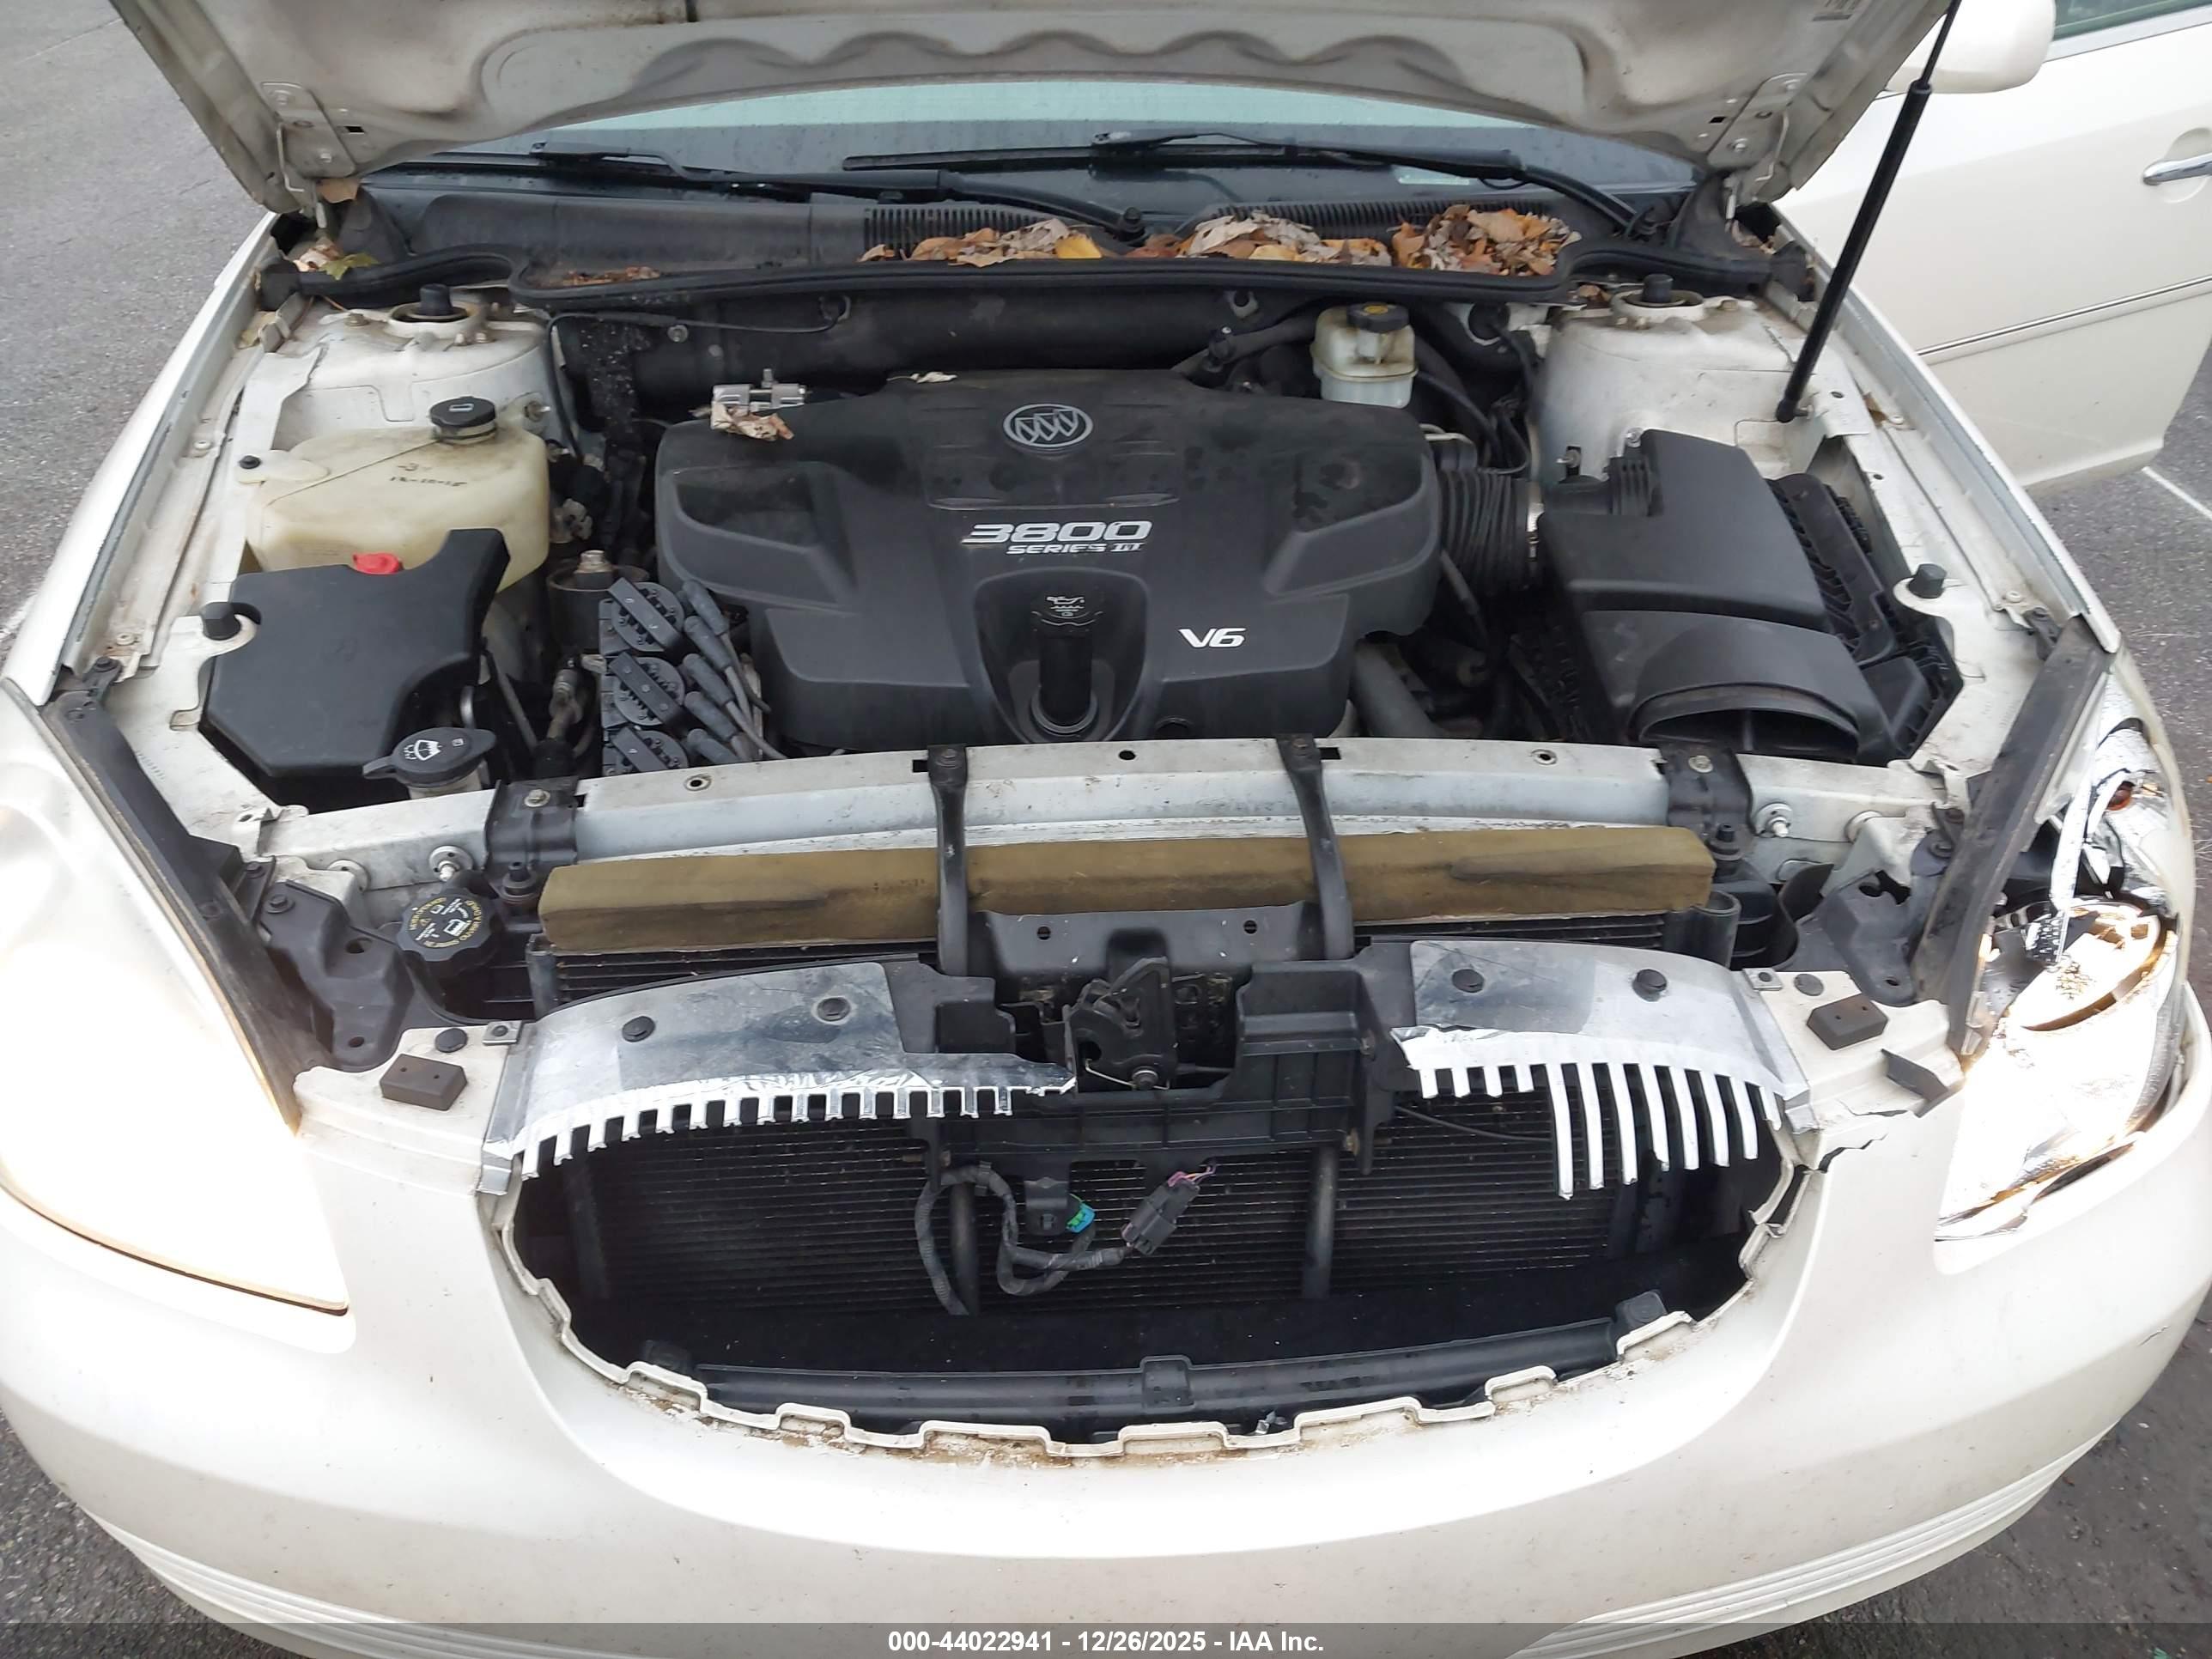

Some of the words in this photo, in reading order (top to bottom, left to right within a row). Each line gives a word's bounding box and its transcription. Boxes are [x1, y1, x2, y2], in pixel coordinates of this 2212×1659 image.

[961, 520, 1152, 544] 3800
[1006, 543, 1108, 555] SERIES
[1178, 627, 1247, 648] V6
